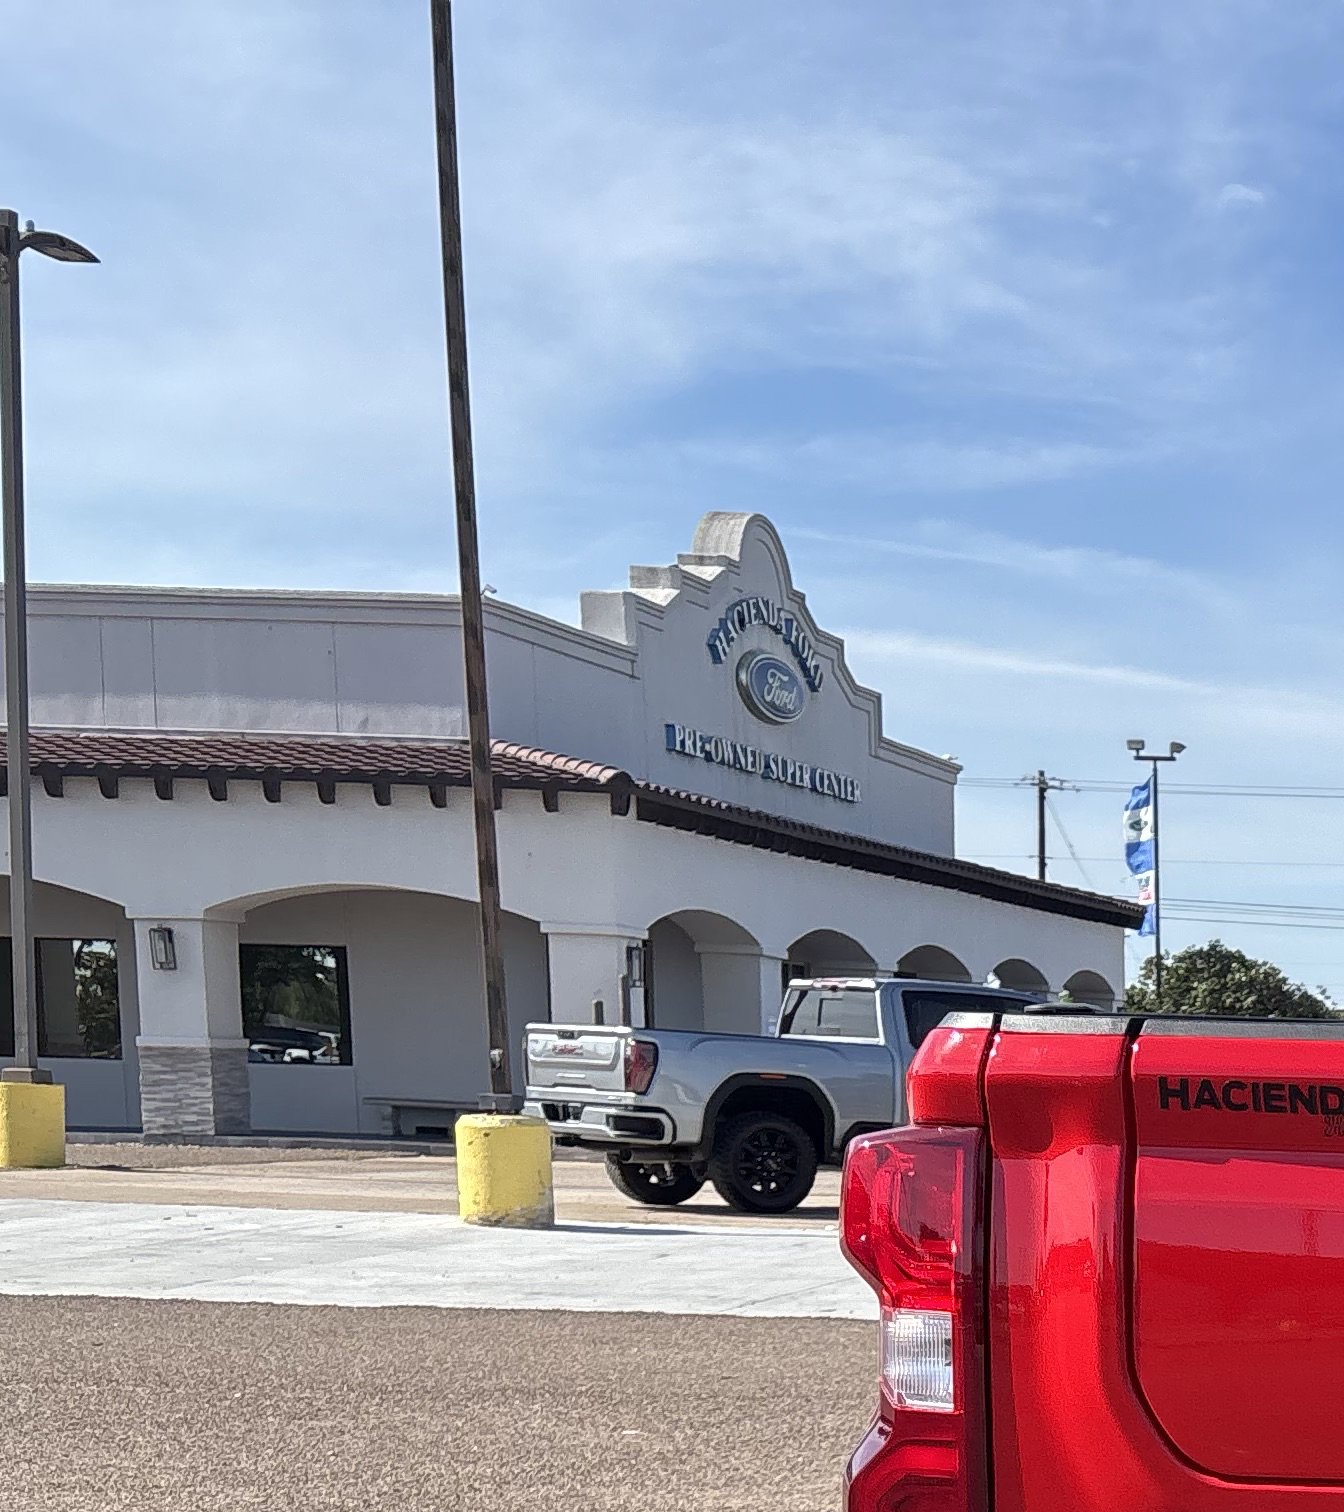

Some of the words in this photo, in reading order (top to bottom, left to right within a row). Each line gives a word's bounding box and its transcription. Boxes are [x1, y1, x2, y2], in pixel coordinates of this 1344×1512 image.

[708, 597, 787, 663] HACIENDA
[763, 668, 798, 711] Ford
[672, 723, 764, 776] PRE-OWNED
[768, 752, 812, 790] SUPER
[814, 766, 862, 803] CENTER
